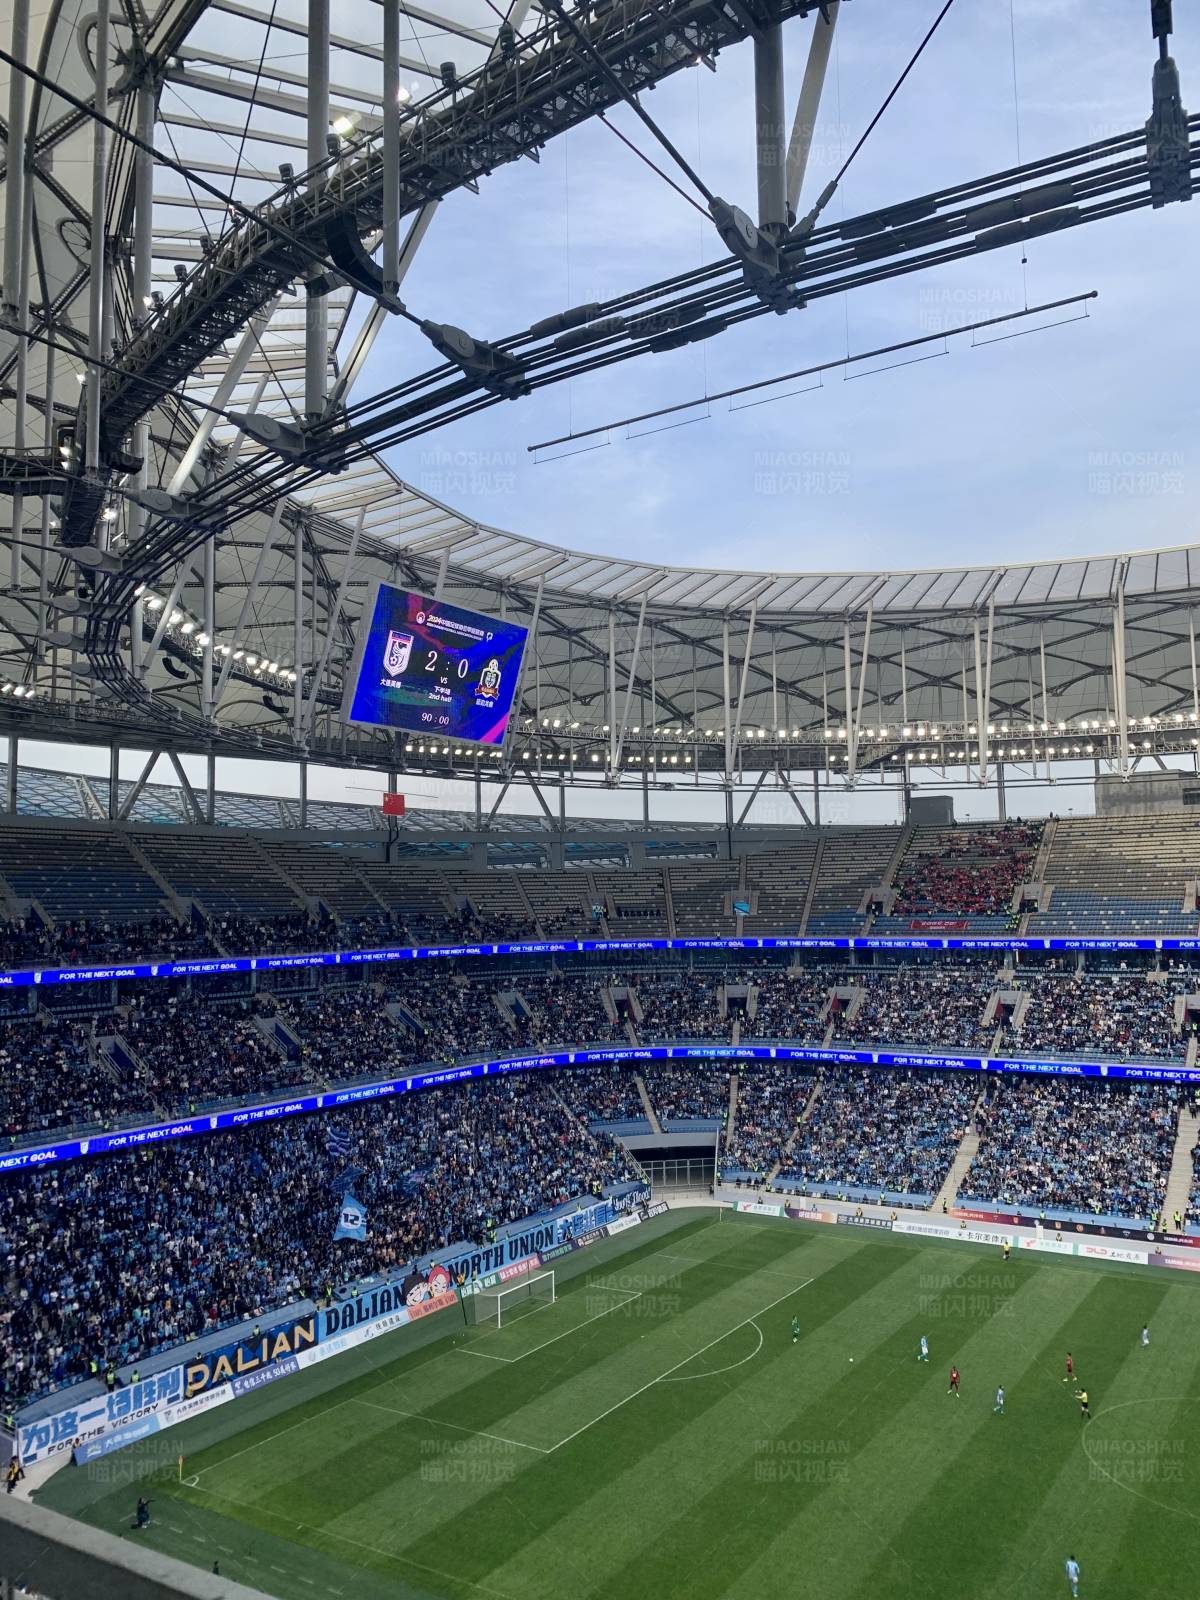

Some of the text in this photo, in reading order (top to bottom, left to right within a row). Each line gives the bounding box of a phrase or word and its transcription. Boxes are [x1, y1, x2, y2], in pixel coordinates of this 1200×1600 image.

[425, 650, 438, 672] 2
[457, 658, 469, 679] 0
[440, 676, 448, 684] VS
[428, 692, 453, 703] 2nd half
[362, 1089, 379, 1097] NEXT
[379, 1086, 395, 1094] GOAL
[233, 1114, 248, 1122] FOR
[265, 1108, 284, 1117] NEXT
[284, 1104, 303, 1113] GOAL
[109, 1125, 193, 1146] FOR THE NEXT GOAL
[0, 1151, 57, 1168] NEXT GOAL
[449, 1244, 504, 1284] NORTH
[509, 1225, 554, 1261] UNION
[187, 1318, 315, 1392] DALIAN
[22, 1368, 180, 1455] 为这一场胜利
[48, 1438, 73, 1455] FOR
[79, 1426, 105, 1443] THE
[111, 1403, 159, 1428] VICTORY
